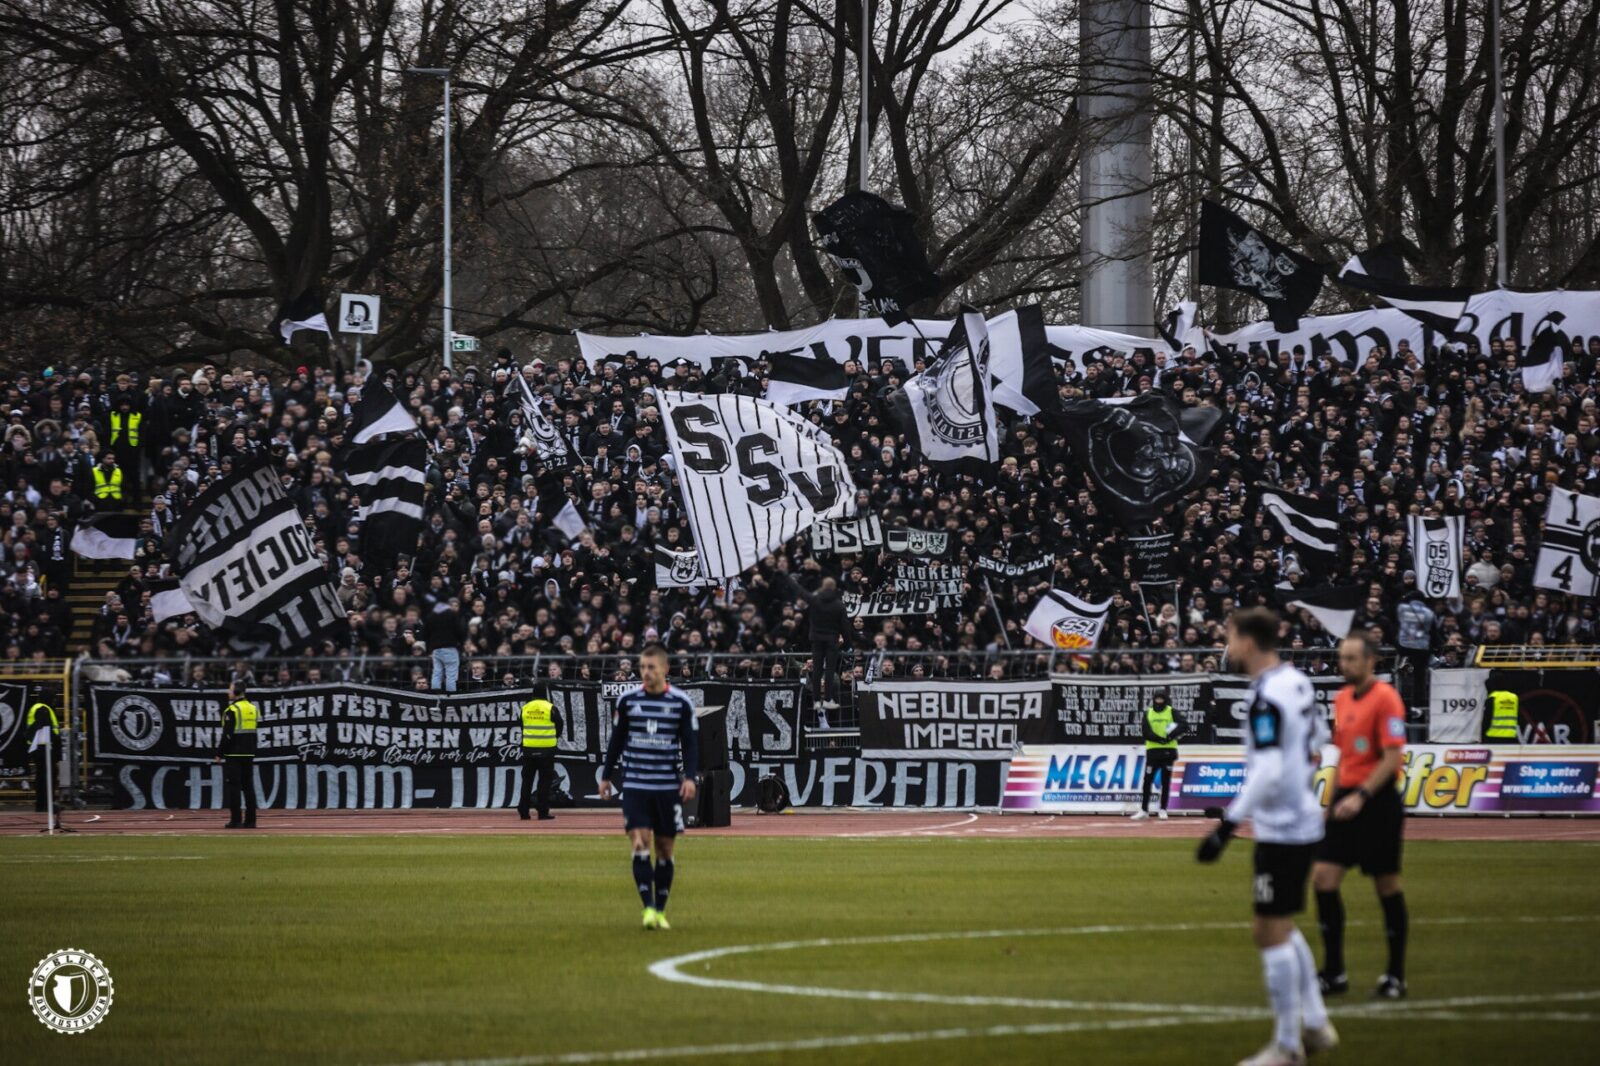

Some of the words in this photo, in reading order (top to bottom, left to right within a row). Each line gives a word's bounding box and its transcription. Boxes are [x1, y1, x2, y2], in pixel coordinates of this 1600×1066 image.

[348, 300, 370, 326] D
[670, 403, 841, 515] SSV
[811, 514, 883, 551] BSU
[897, 564, 961, 580] BROKEN
[1552, 555, 1573, 591] 4
[867, 591, 935, 614] 1846
[170, 699, 220, 721] WIR
[331, 694, 392, 718] FEST
[877, 692, 1042, 720] NEBULOSA
[1441, 698, 1478, 714] 1999
[175, 726, 224, 748] UN
[256, 723, 328, 749] EHEN
[337, 722, 461, 748] UNSEREN
[904, 722, 1015, 749] IMPERO
[1516, 721, 1571, 745] VAR
[333, 747, 377, 760] unsere
[466, 748, 491, 761] den
[1198, 765, 1227, 779] Shop
[1519, 766, 1547, 779] Shop
[1551, 767, 1581, 777] unter
[1043, 793, 1093, 802] Wohntrends
[1095, 794, 1112, 802] zum
[1502, 783, 1590, 794] www.inhofer.de
